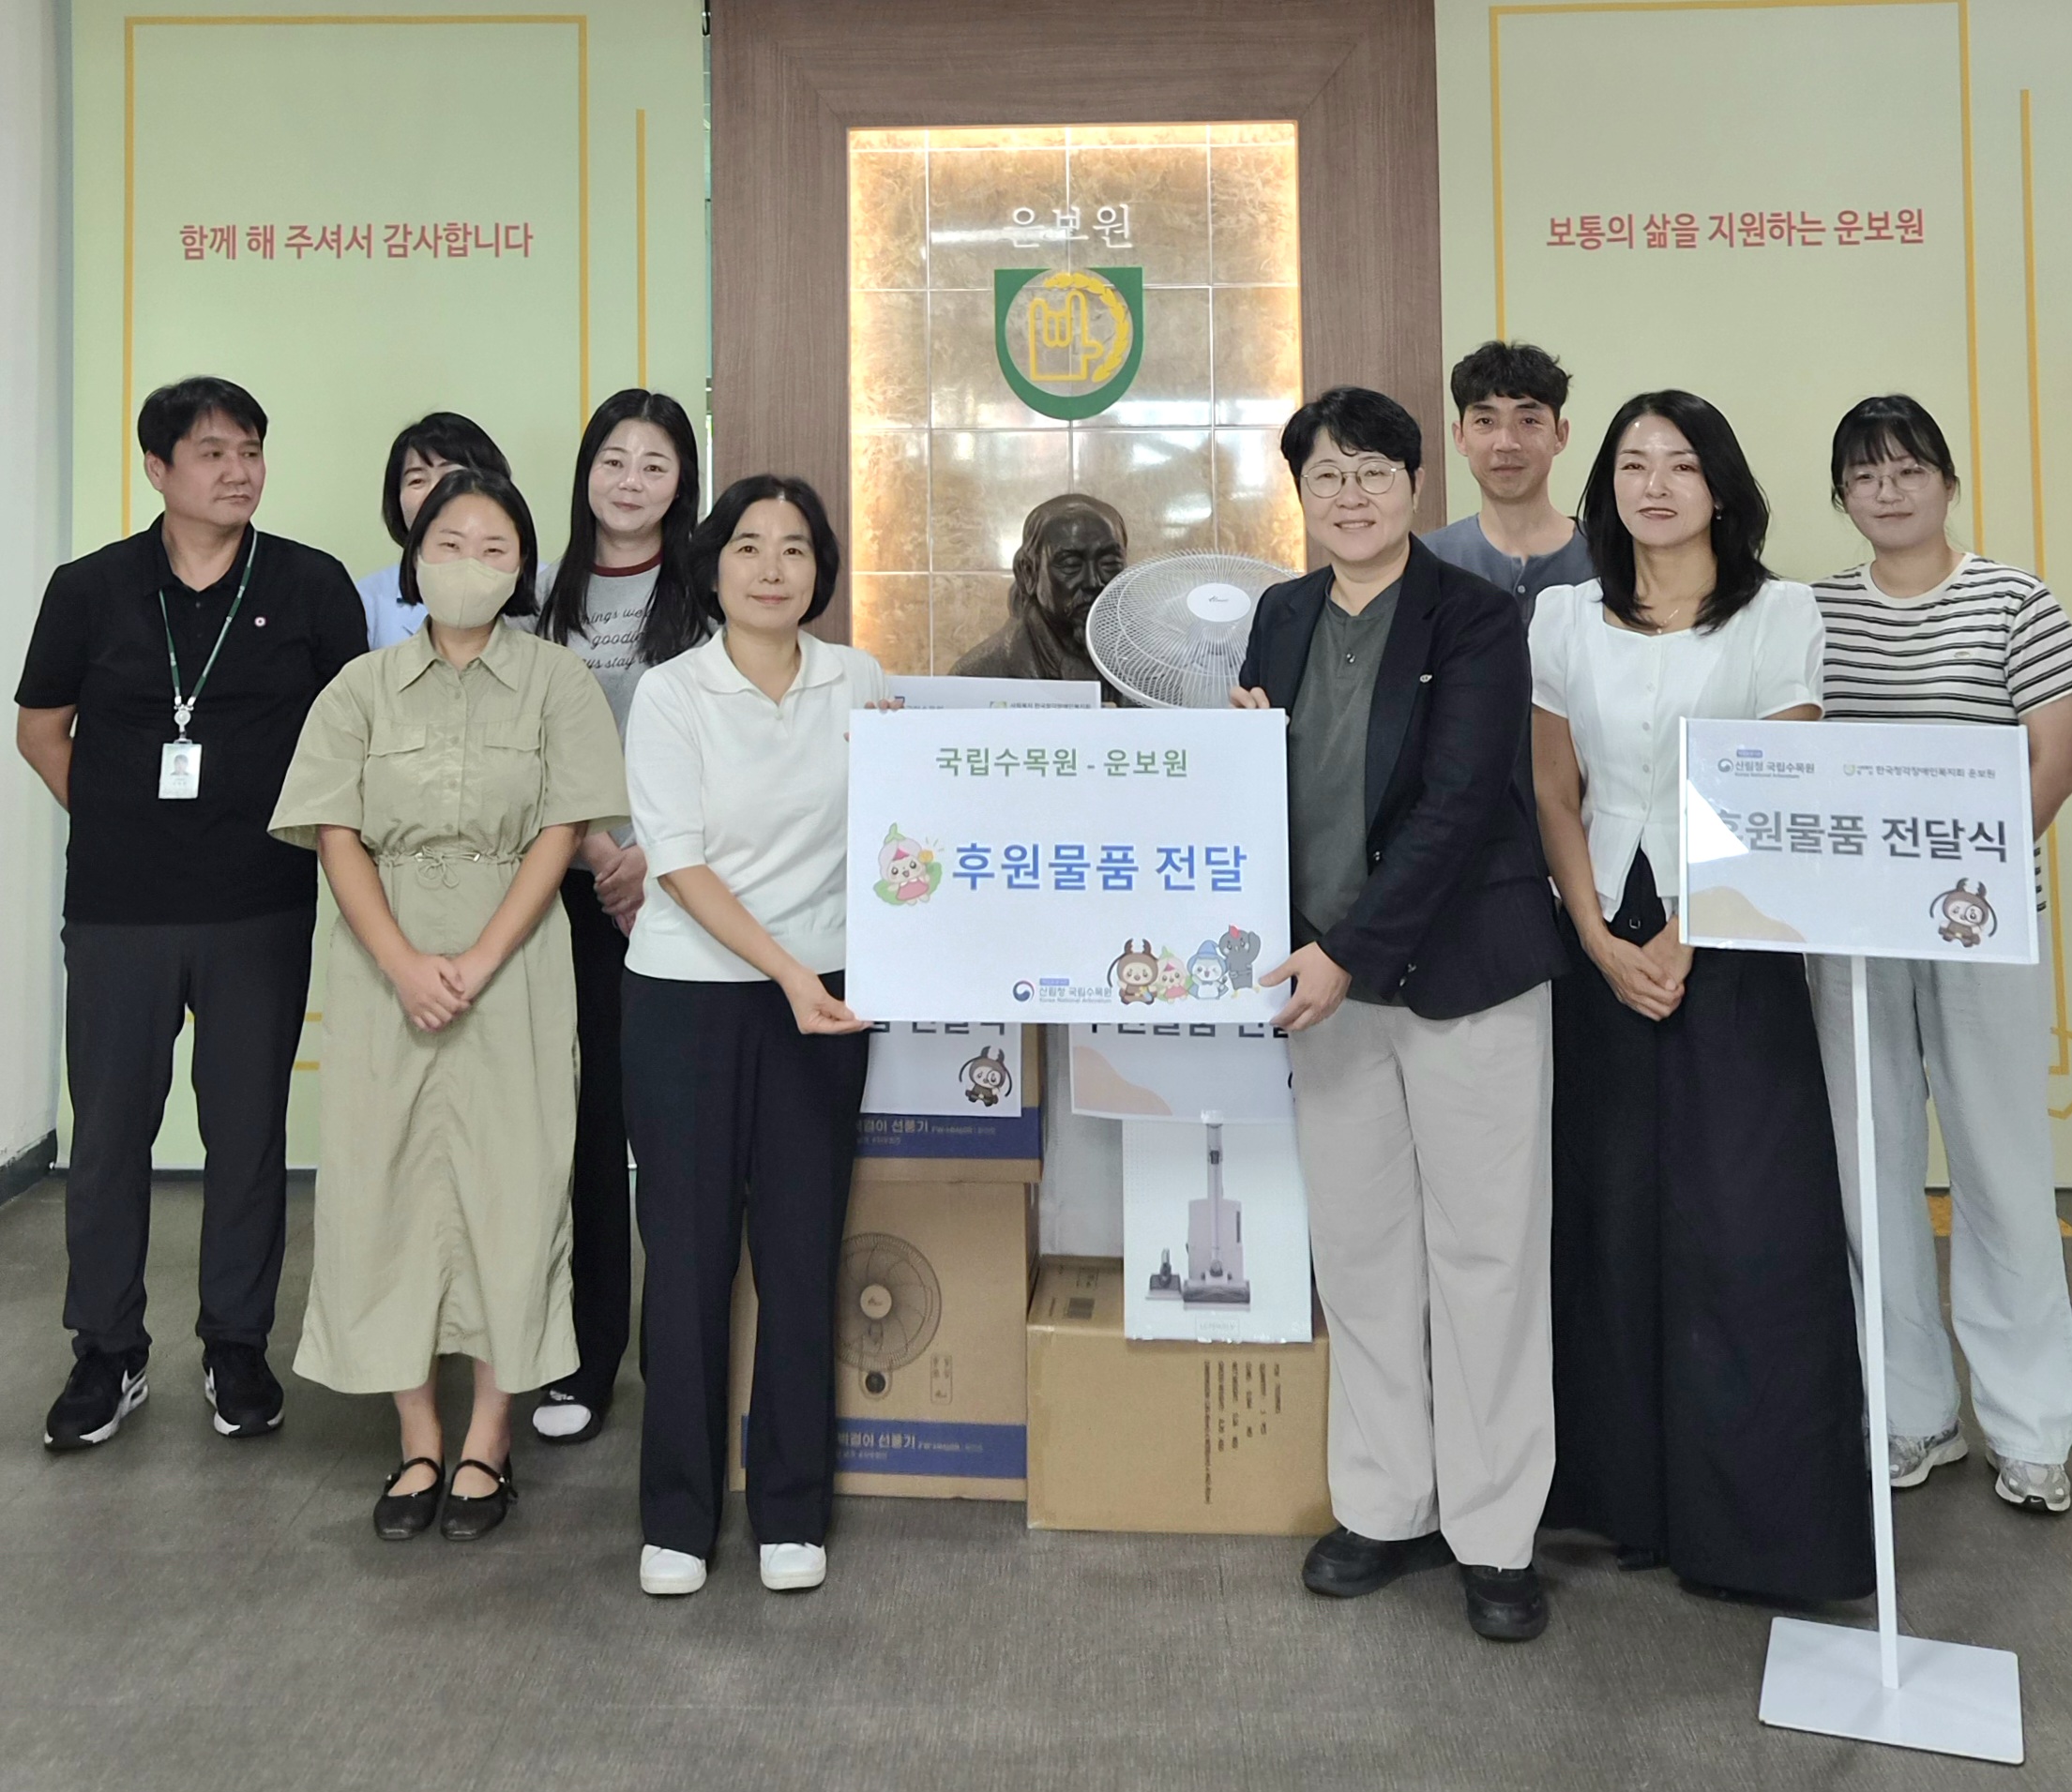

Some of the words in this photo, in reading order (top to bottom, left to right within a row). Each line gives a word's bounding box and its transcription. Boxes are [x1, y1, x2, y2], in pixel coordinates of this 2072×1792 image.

[179, 224, 237, 261] 함께
[246, 223, 276, 260] 해
[283, 223, 373, 260] 주셔서
[382, 221, 534, 259] 감사합니다
[1545, 213, 1635, 250] 보통의
[1641, 212, 1701, 249] 삶을
[1707, 210, 1827, 248] 지원하는
[1833, 208, 1925, 247] 운보원
[935, 747, 1078, 777] 국립수목원
[1103, 748, 1188, 777] 운보원
[1766, 761, 1815, 774] 국립수목원
[1881, 816, 2007, 863] 전달식
[951, 842, 1140, 892] 후원물품
[1155, 844, 1248, 893] 전달
[1038, 986, 1066, 998] 산림청
[1068, 986, 1112, 998] 국립수목원
